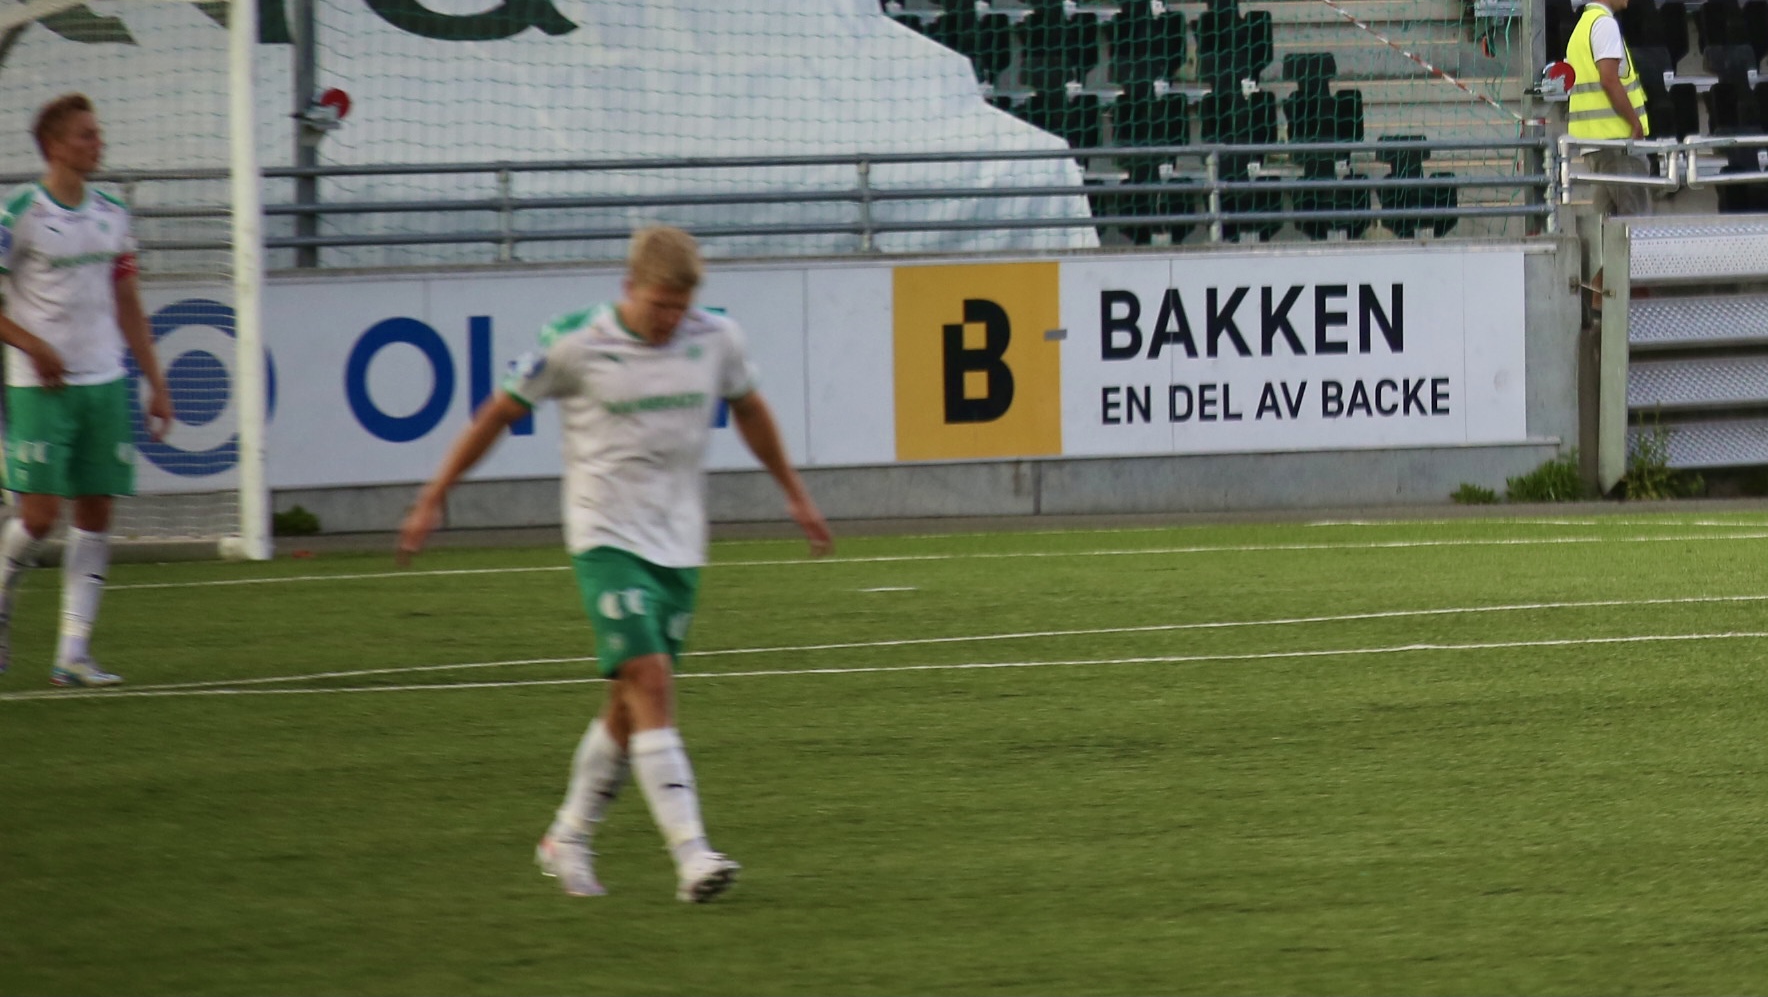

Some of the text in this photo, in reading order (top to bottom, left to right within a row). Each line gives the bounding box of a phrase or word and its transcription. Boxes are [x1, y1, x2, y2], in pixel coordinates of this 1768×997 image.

[1100, 283, 1404, 361] BAKKEN
[1102, 377, 1450, 425] EN DEL AV BACKE
